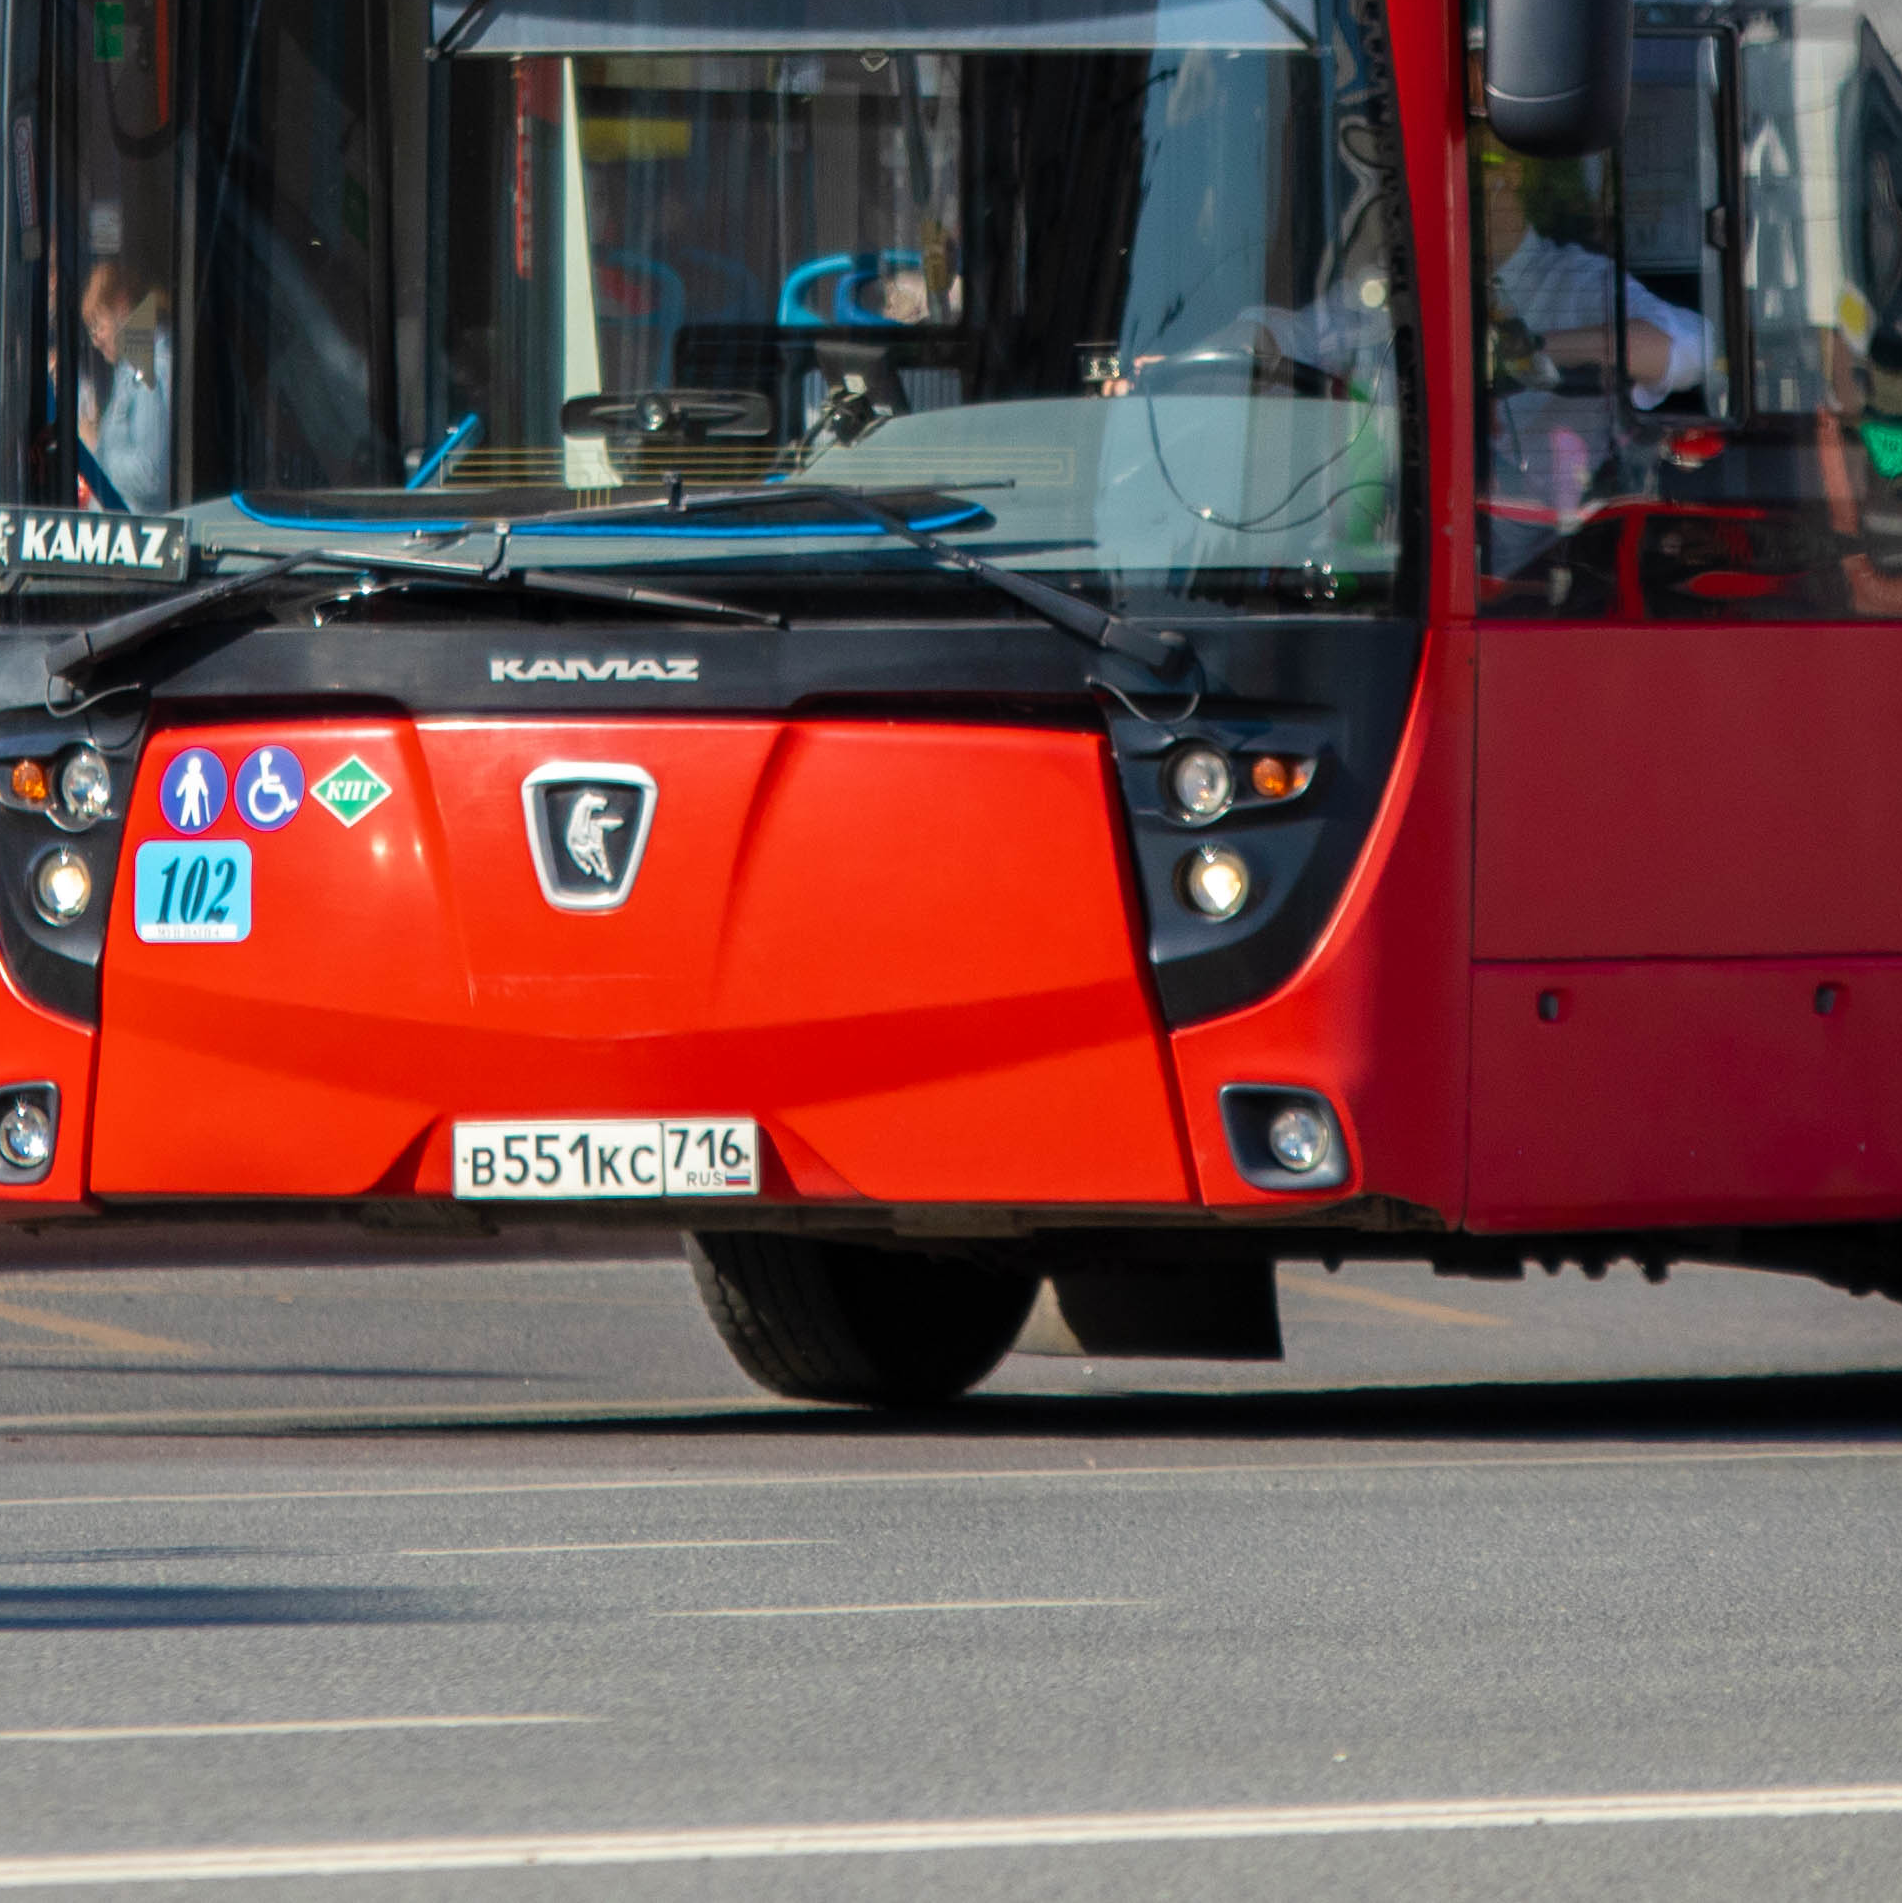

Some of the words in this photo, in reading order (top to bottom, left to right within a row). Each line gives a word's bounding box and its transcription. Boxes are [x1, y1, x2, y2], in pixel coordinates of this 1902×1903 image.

[21, 518, 169, 569] KAMAZ
[491, 657, 699, 682] KAMAZ
[156, 855, 238, 925] 102
[668, 1128, 743, 1169] 716
[687, 1171, 724, 1187] RUS
